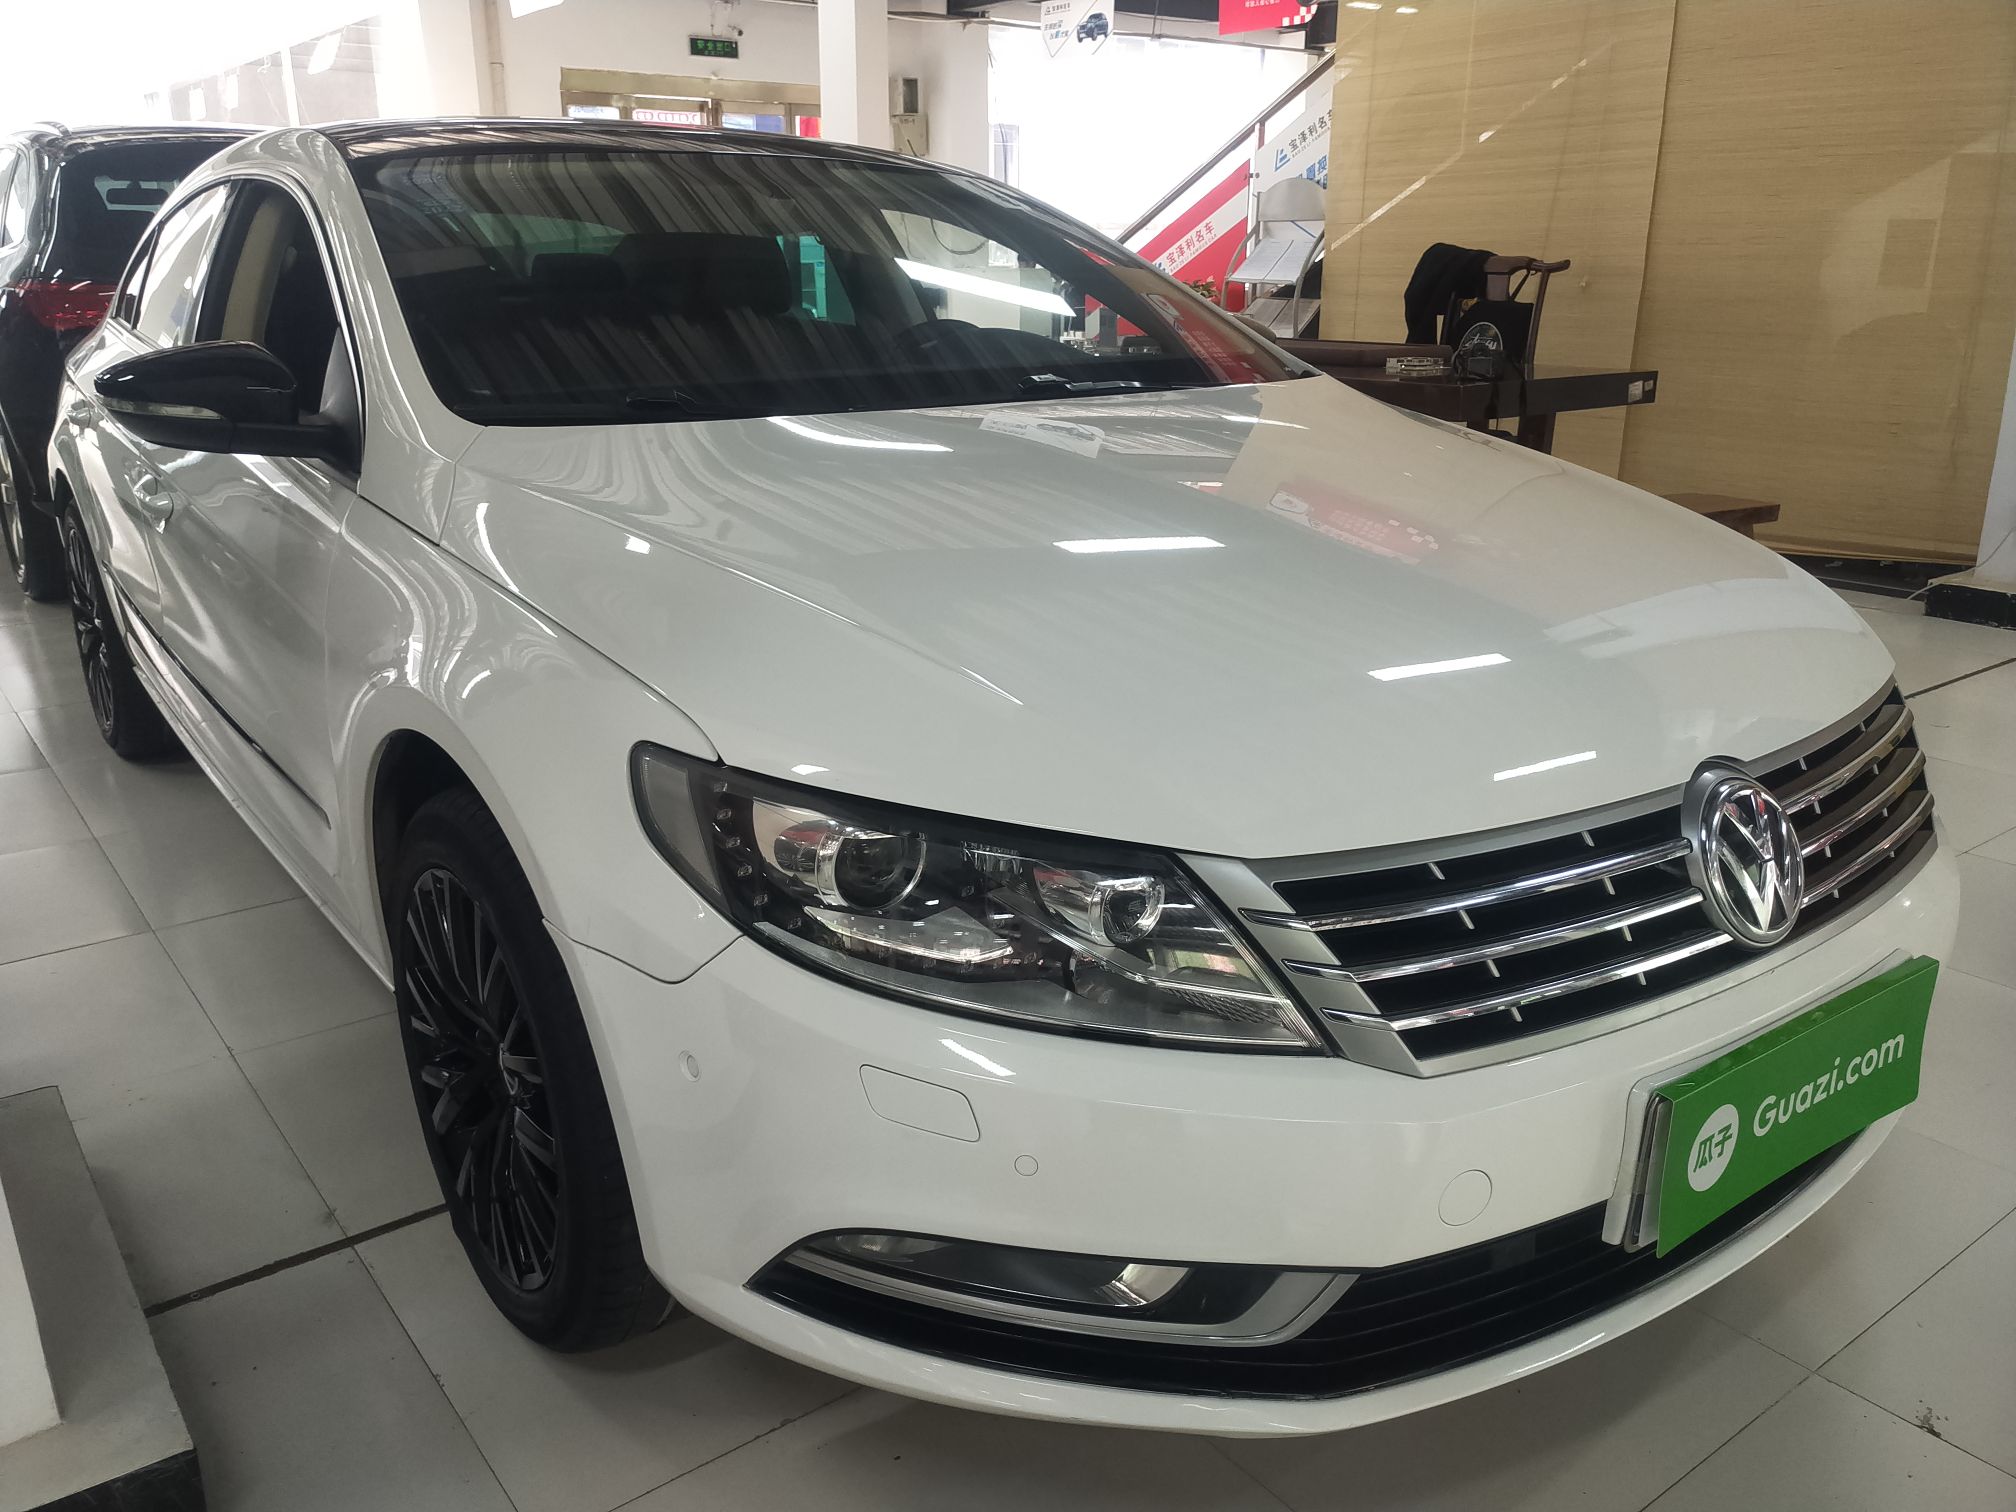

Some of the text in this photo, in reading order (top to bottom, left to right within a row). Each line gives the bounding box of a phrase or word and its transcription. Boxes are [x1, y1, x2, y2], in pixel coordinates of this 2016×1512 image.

[1167, 221, 1214, 267] 宝泽利名车
[1753, 1033, 1905, 1137] Guazi.com
[1692, 1122, 1733, 1173] 瓜子
